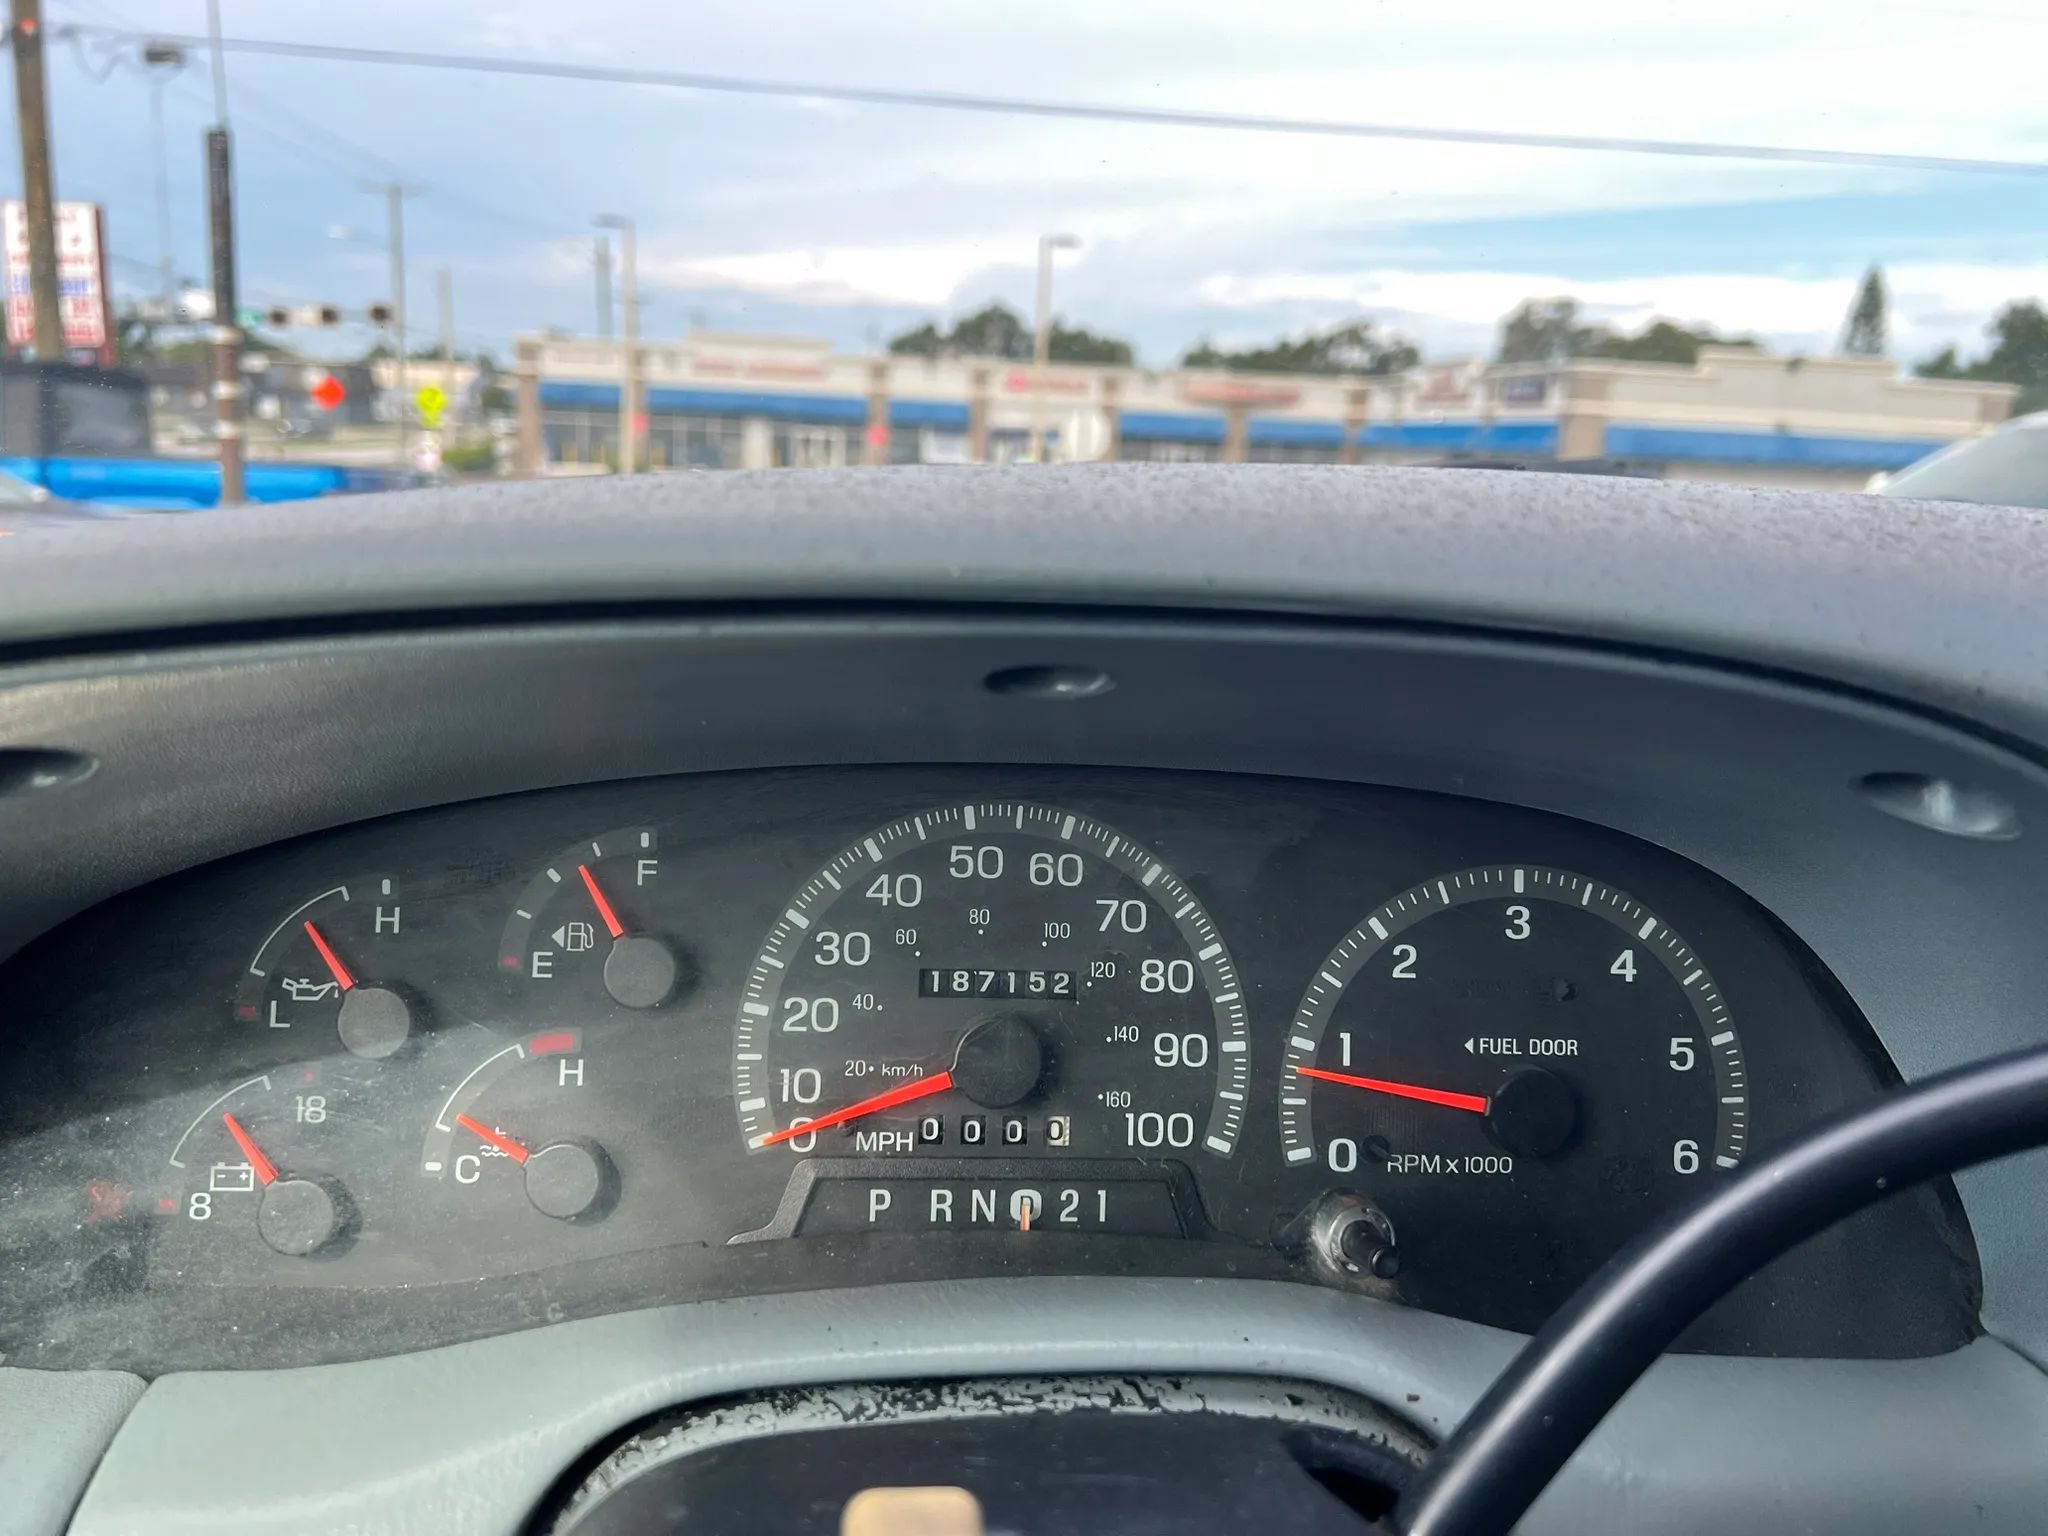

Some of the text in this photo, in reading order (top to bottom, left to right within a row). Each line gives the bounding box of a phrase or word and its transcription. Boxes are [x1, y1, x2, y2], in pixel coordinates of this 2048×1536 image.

[638, 860, 657, 885] F
[950, 846, 1003, 878] 50
[1030, 853, 1083, 886] 60
[866, 874, 921, 907] 40
[376, 907, 400, 933] H
[970, 909, 989, 924] 80
[1096, 900, 1146, 932] 70
[1505, 906, 1530, 939] 3
[896, 929, 916, 944] 60
[1045, 923, 1070, 938] 100
[815, 932, 870, 965] 30
[1393, 945, 1416, 978] 2
[532, 952, 553, 978] E
[1091, 962, 1115, 977] 120
[1141, 960, 1193, 993] 80
[1611, 950, 1636, 982] 4
[932, 971, 1069, 993] 187152
[270, 1001, 290, 1027] L
[783, 998, 838, 1032] 20
[853, 994, 873, 1010] 40
[1115, 1026, 1138, 1042] 140
[1480, 1038, 1577, 1055] FUEL DOOR
[1155, 1033, 1207, 1067] 90
[1340, 1033, 1350, 1066] 1
[1670, 1038, 1694, 1071] 5
[559, 1059, 583, 1086] H
[845, 1060, 865, 1076] 20
[882, 1064, 922, 1076] km/h
[781, 1068, 821, 1103] 10
[1107, 1091, 1130, 1107] 160
[296, 1096, 326, 1123] 18
[789, 1117, 816, 1152] 0
[856, 1132, 913, 1151] MPH
[1126, 1113, 1193, 1147] 100
[456, 1155, 480, 1183] C
[1329, 1139, 1356, 1172] 0
[1674, 1140, 1698, 1173] 6
[189, 1192, 212, 1220] 8
[870, 1189, 890, 1221] P
[931, 1190, 952, 1221] R
[972, 1190, 995, 1222] N
[1060, 1189, 1078, 1221] 2
[1098, 1190, 1106, 1222] 1
